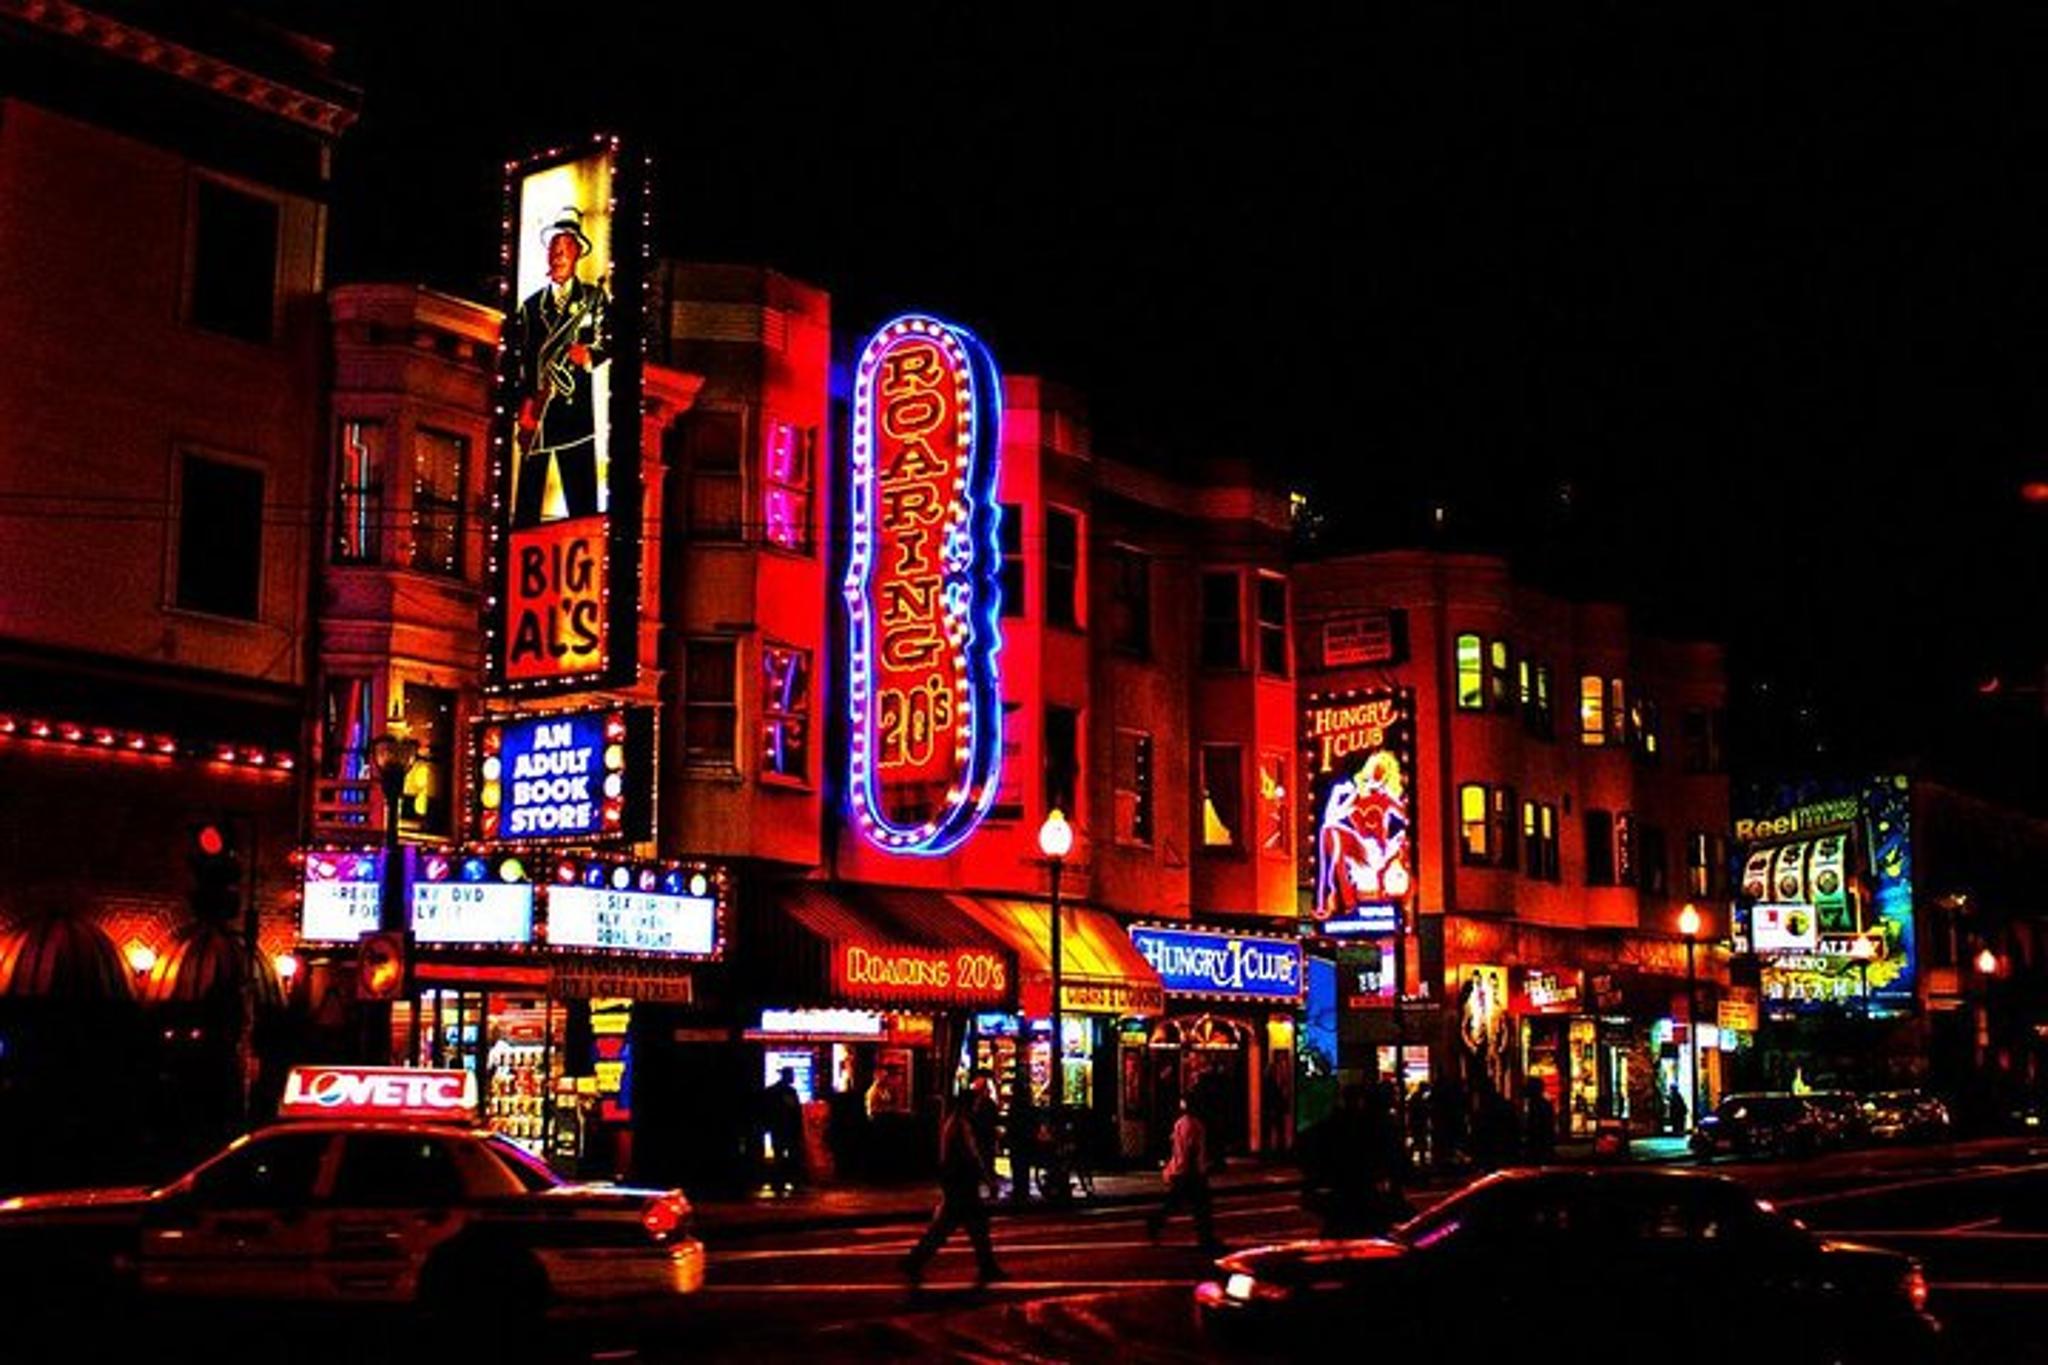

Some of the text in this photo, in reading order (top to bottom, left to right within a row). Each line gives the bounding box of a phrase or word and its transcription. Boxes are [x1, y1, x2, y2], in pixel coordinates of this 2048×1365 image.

[520, 539, 595, 598] BIG
[877, 346, 953, 768] ROARING 20's
[511, 598, 599, 664] AL'S
[1315, 699, 1398, 734] HUNGRY
[533, 722, 573, 750] AN
[1333, 726, 1384, 757] CLUB
[513, 747, 593, 780] ADULT
[512, 776, 590, 806] BOOK
[510, 803, 592, 834] STORE
[1735, 809, 1799, 840] Reel
[450, 886, 486, 903] DVD
[846, 946, 1005, 991] ROARING 20's
[1137, 934, 1233, 987] HUNGRY
[1243, 948, 1297, 986] CLUB
